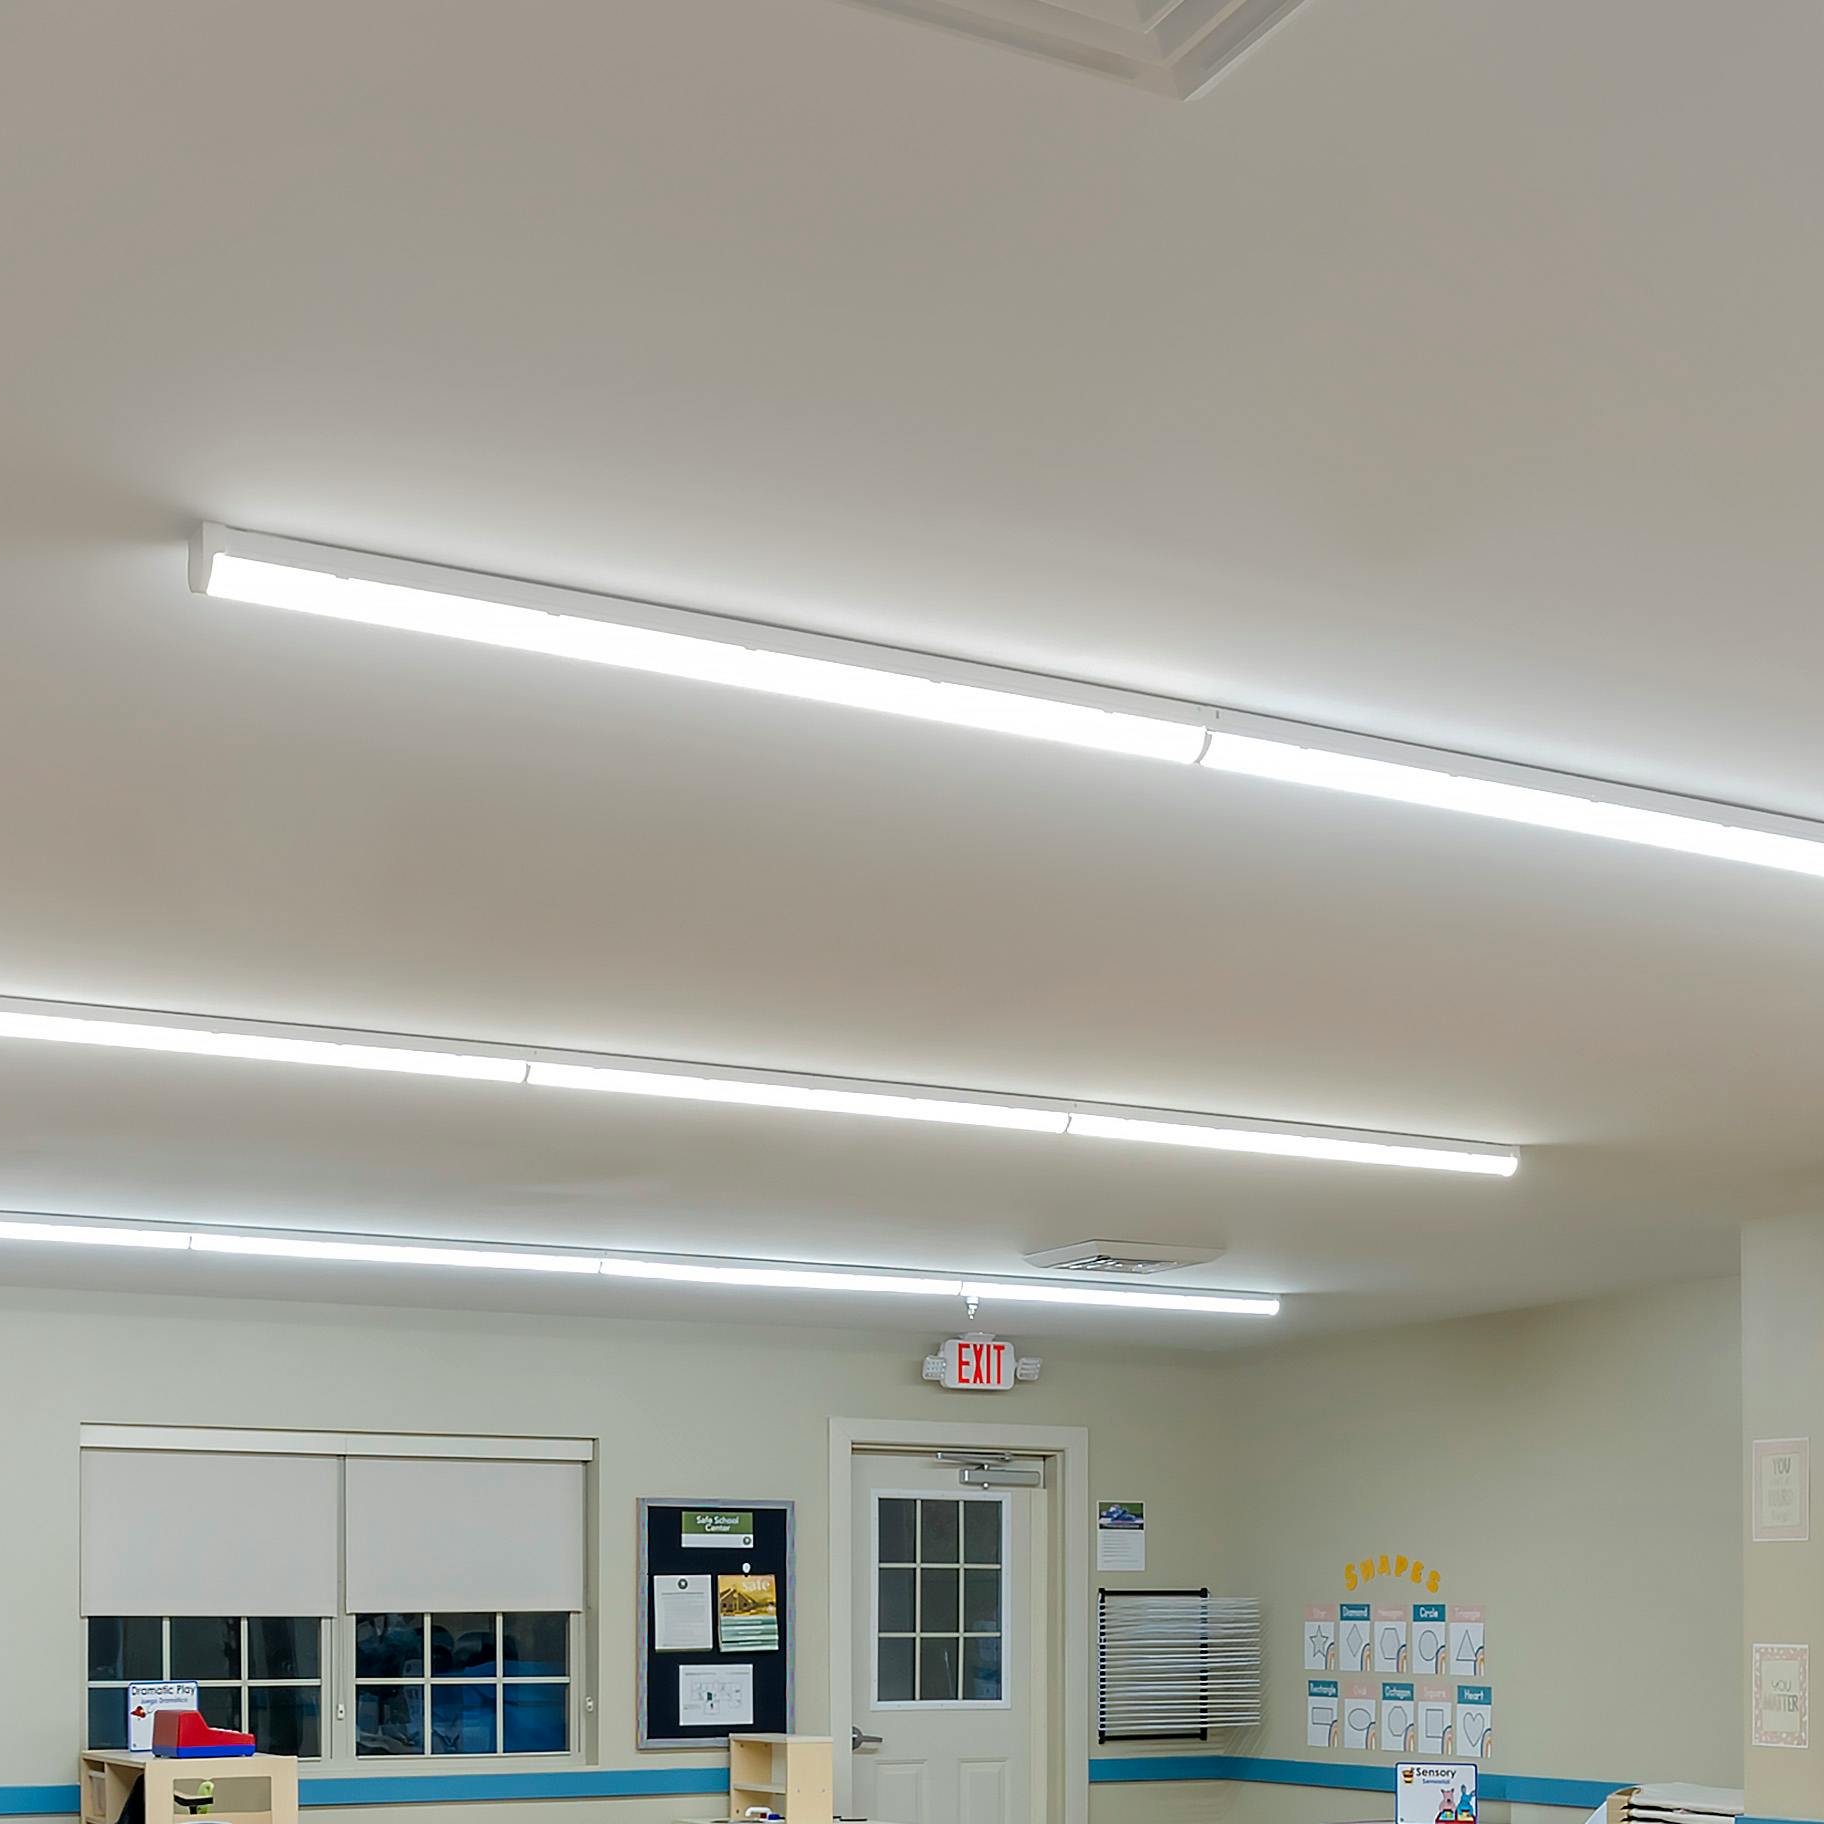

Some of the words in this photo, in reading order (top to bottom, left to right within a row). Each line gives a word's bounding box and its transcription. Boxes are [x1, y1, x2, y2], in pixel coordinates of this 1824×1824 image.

[957, 1343, 1006, 1385] EXIT
[1344, 1555, 1441, 1593] SHAPES
[177, 1685, 195, 1696] Play
[1416, 1767, 1457, 1779] Sensory
